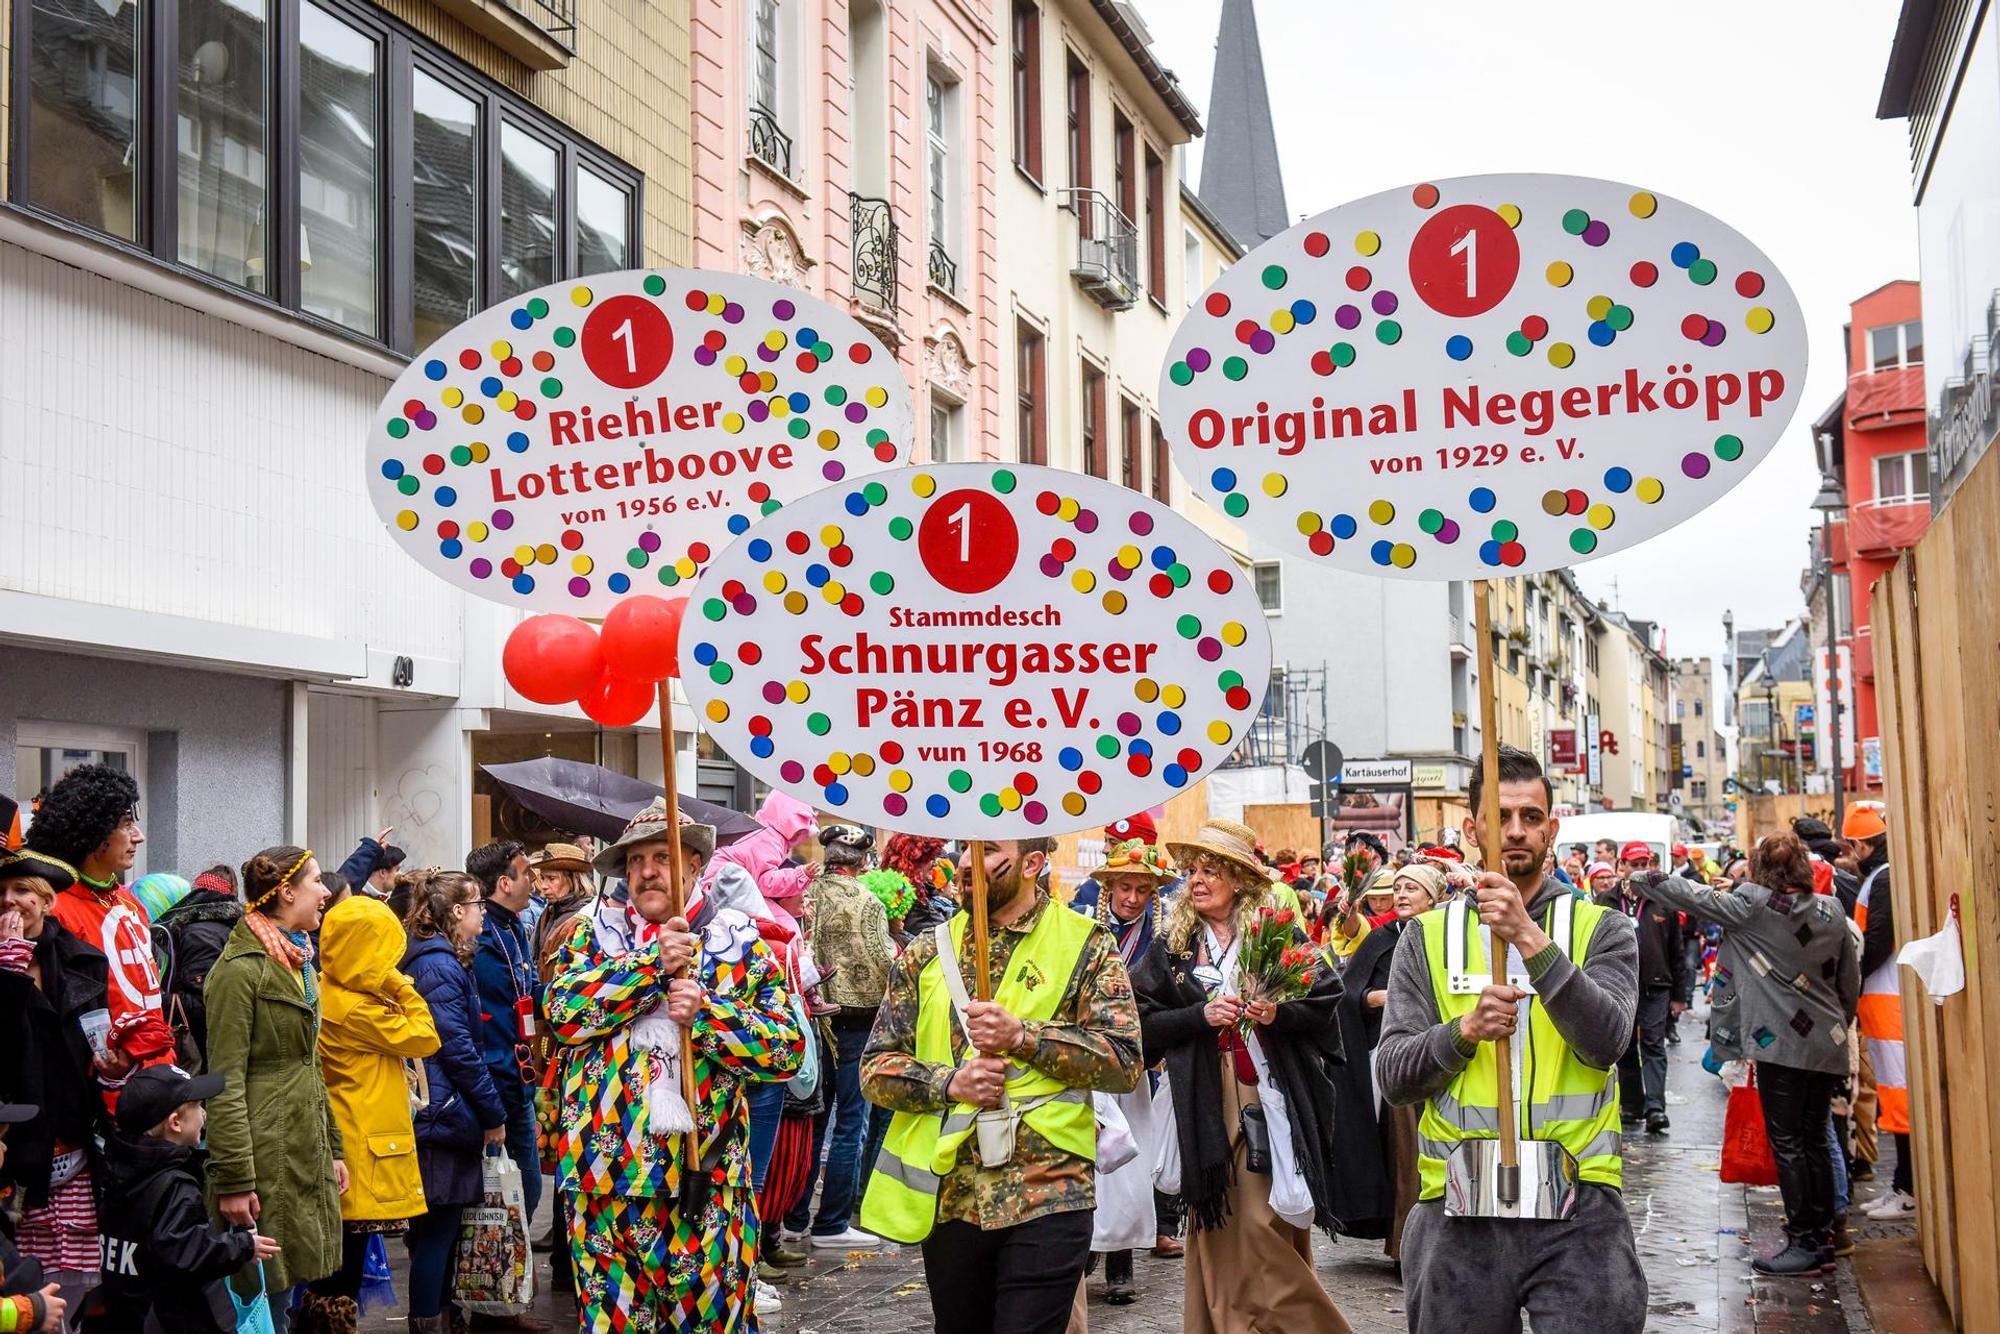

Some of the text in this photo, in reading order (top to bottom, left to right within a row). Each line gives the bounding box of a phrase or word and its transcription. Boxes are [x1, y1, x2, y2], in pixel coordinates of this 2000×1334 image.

[1451, 229, 1477, 298] 1
[612, 319, 637, 373] 1
[549, 395, 722, 447] Riehler
[1187, 363, 1785, 457] Original Negerköpp
[490, 443, 793, 503] Lotterboove
[1370, 437, 1585, 475] von 1929 e. V.
[560, 490, 730, 525] von 1956 e.V.
[948, 503, 970, 562] 1
[889, 604, 1061, 628] Stammdesch
[800, 633, 1159, 688] Schnurgasser
[857, 687, 1101, 730] Pänz e.V.
[918, 741, 1044, 763] vun 1968
[1345, 767, 1407, 778] Kartäuserhof
